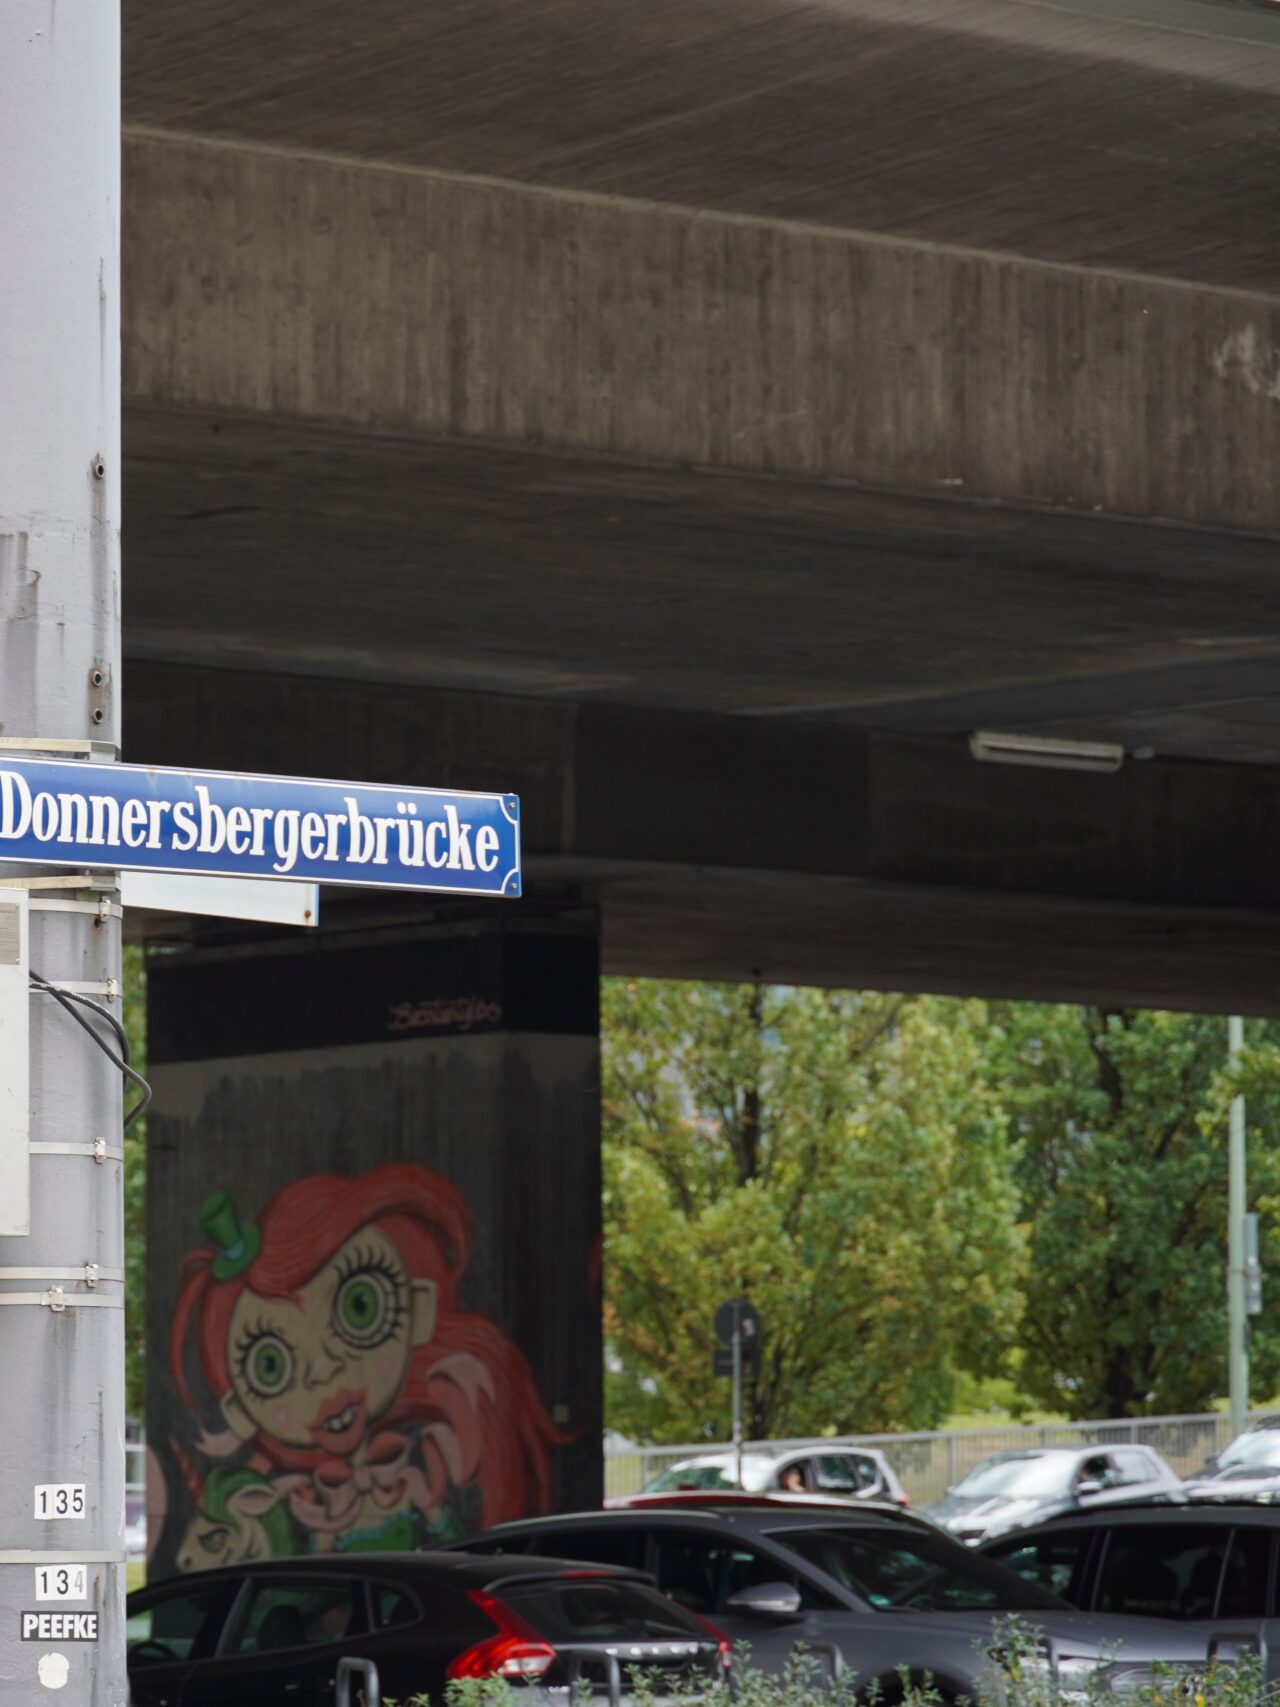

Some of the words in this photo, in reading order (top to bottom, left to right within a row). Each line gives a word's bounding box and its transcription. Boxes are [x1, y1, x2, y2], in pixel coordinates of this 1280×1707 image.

[40, 1488, 84, 1514] 135
[40, 1569, 84, 1595] 134
[22, 1613, 98, 1639] PEEFKE
